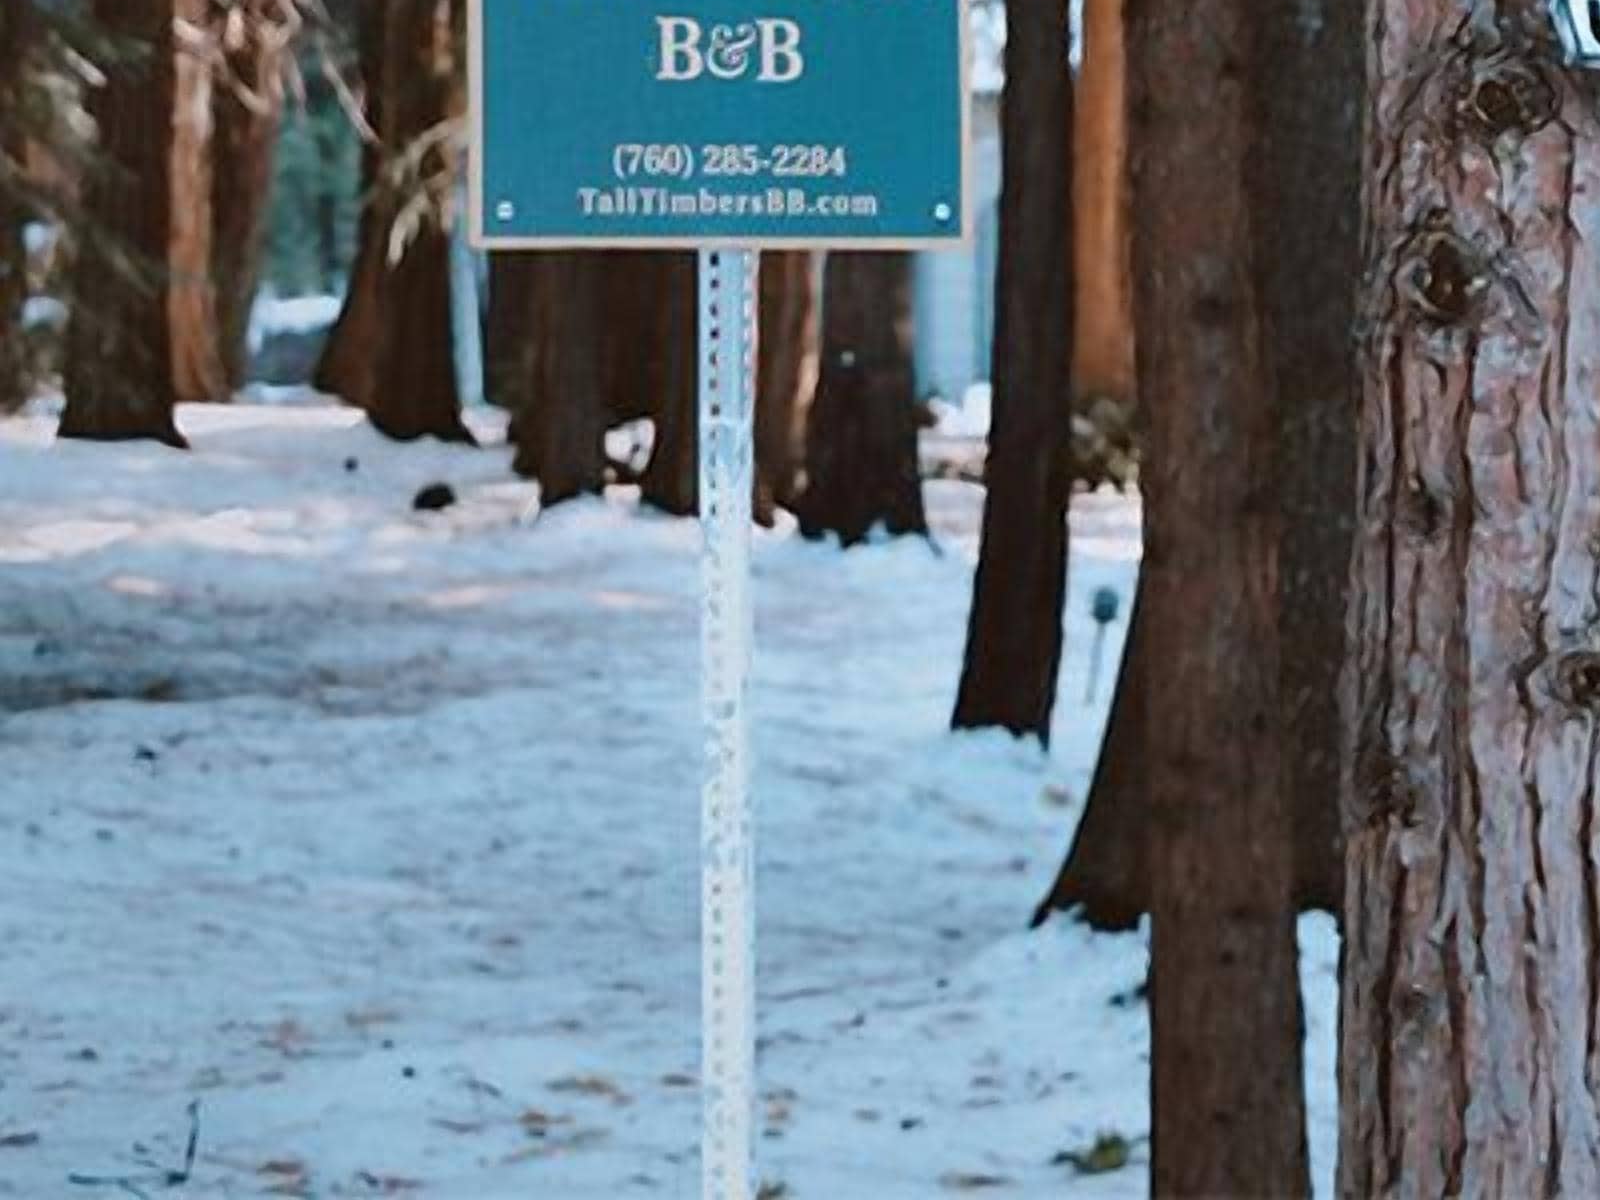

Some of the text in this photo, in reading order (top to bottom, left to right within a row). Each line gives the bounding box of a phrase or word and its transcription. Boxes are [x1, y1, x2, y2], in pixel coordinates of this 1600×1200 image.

[655, 15, 804, 82] B&B
[613, 143, 847, 180] (760) 285-2284
[577, 187, 879, 217] TallTimbersBB.com
